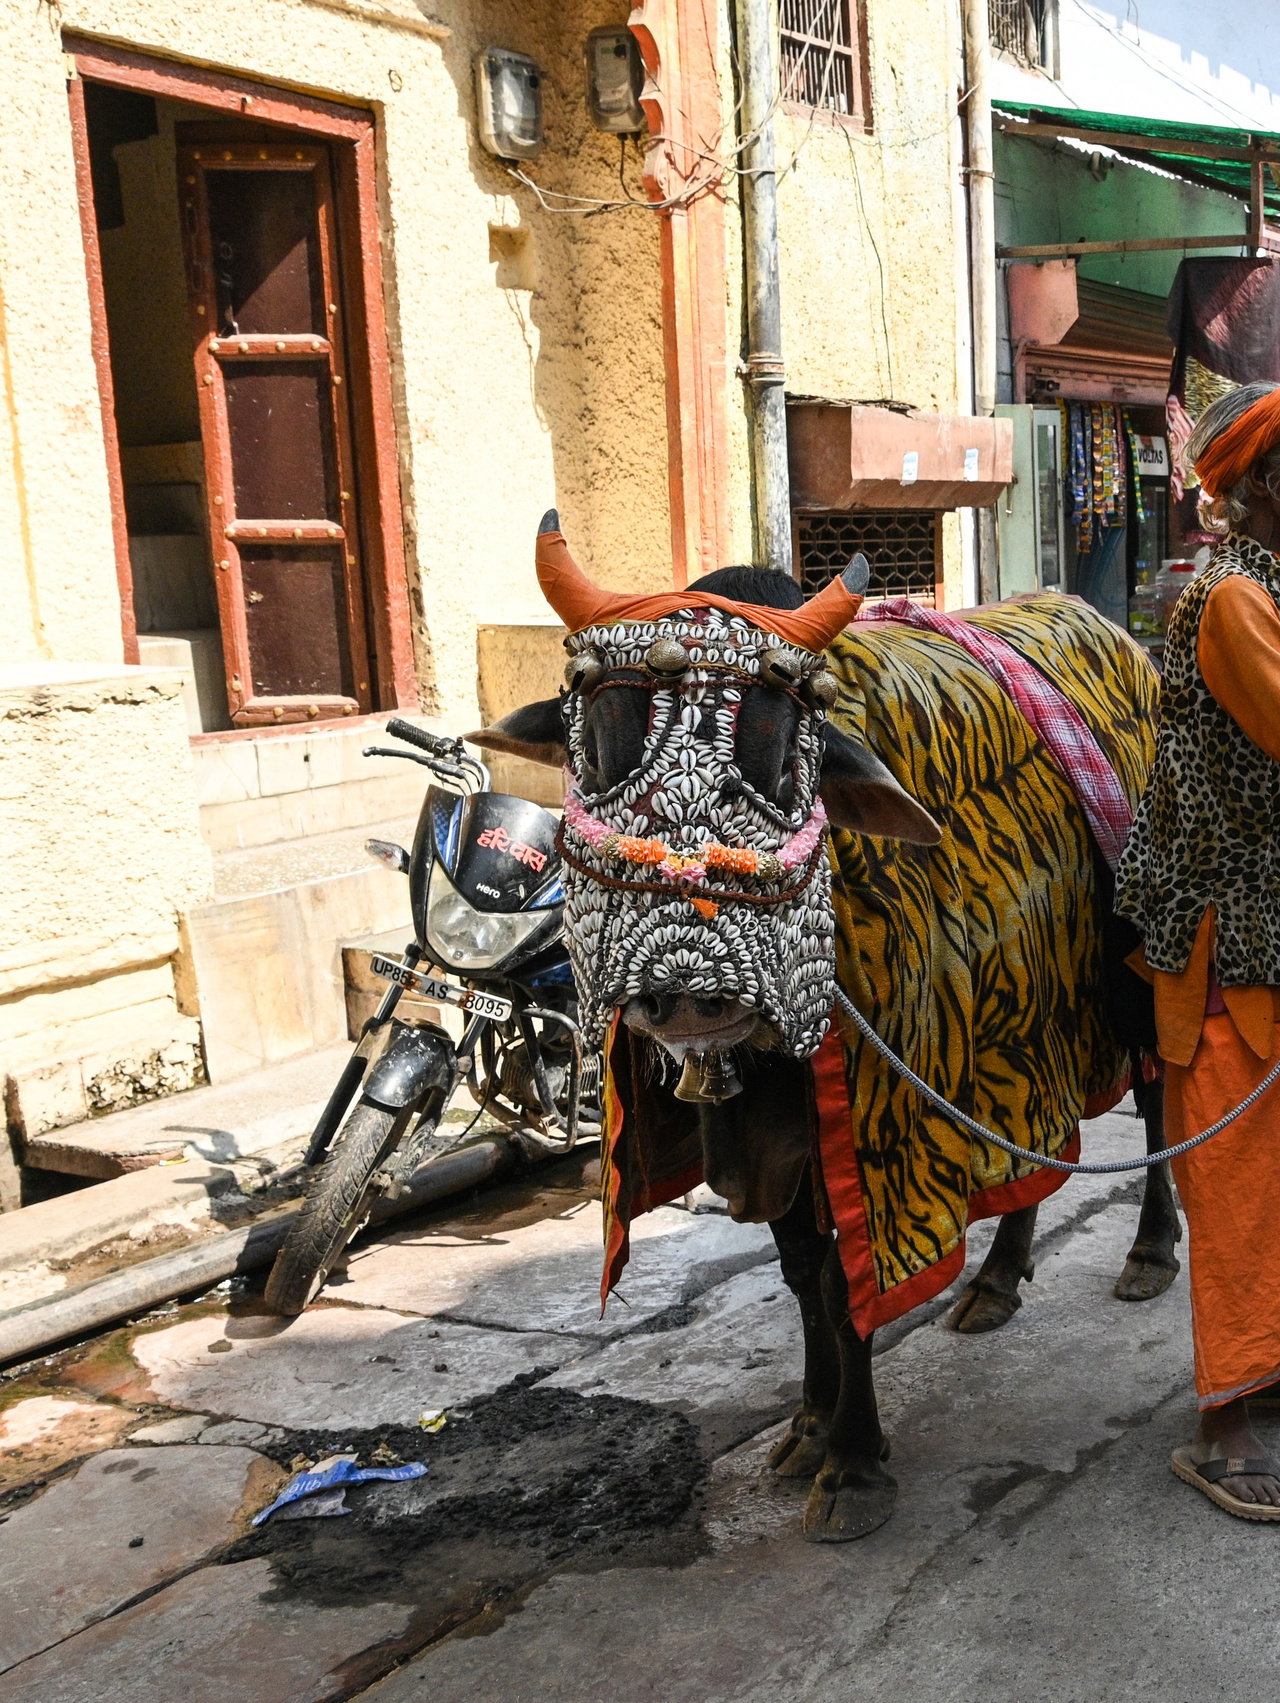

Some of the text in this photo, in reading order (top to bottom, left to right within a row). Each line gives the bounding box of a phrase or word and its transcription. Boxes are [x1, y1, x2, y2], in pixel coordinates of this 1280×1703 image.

[1138, 448, 1164, 465] VOLTAS
[475, 882, 501, 899] Hero
[425, 981, 449, 1000] AS
[464, 994, 506, 1018] 8095
